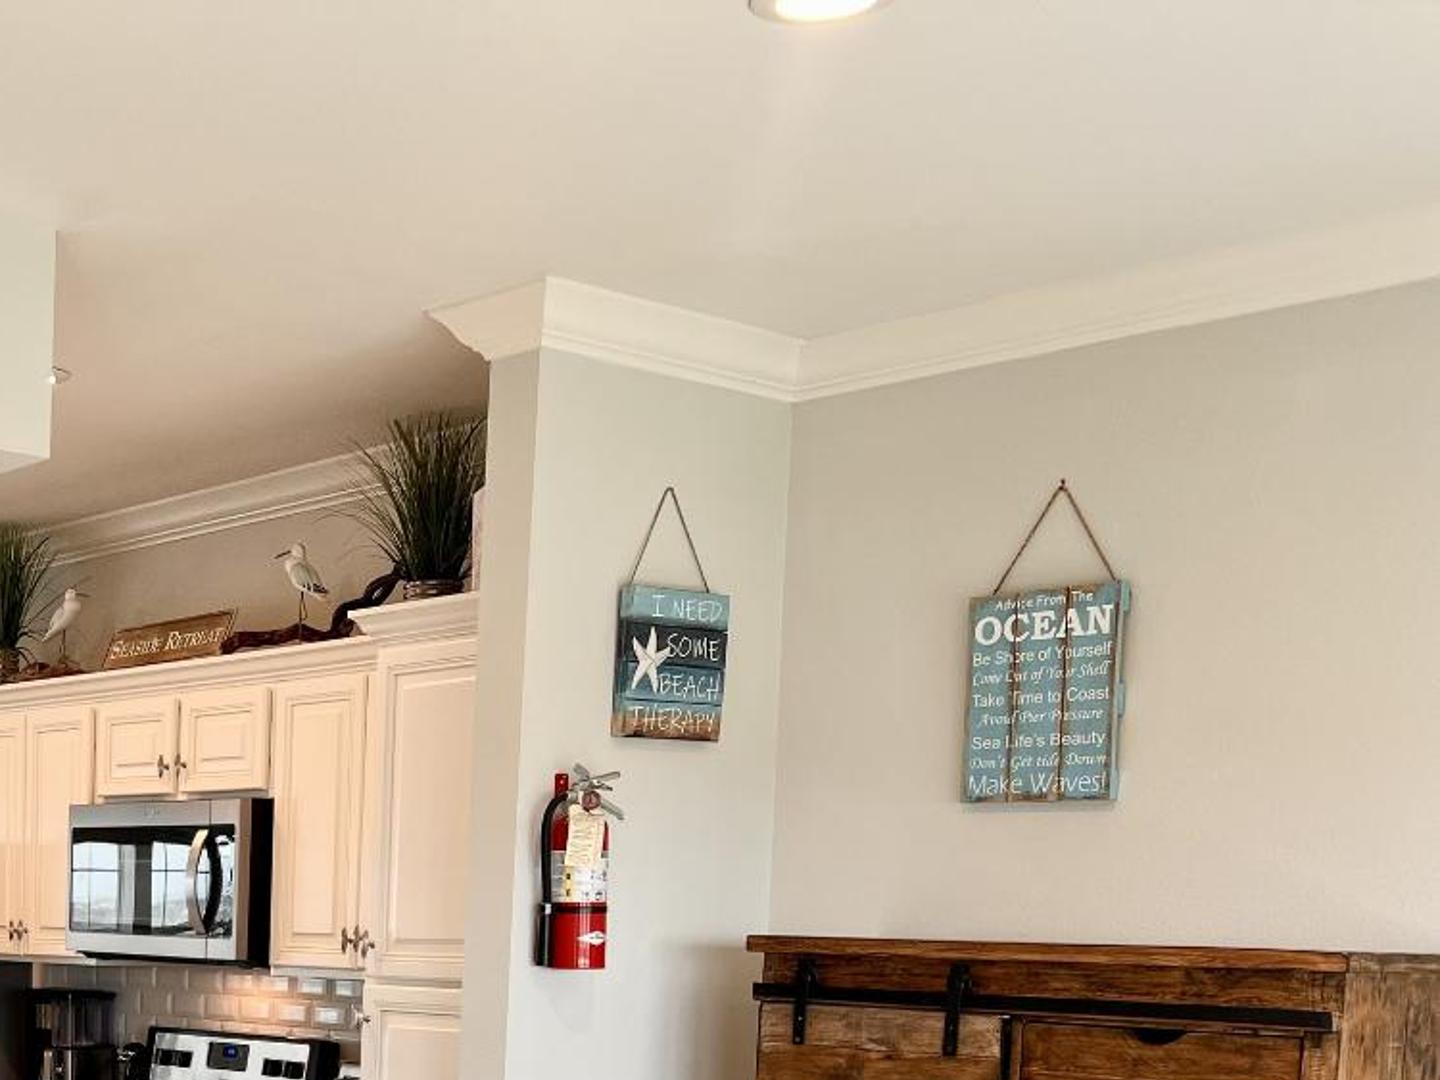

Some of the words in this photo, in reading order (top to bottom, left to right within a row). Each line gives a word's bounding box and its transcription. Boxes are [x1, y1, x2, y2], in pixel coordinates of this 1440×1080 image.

[652, 594, 665, 618] I
[673, 599, 723, 622] NEED
[1036, 594, 1067, 608] From
[1071, 590, 1094, 602] The
[974, 604, 1115, 646] OCEAN
[667, 632, 721, 662] SOME
[972, 652, 991, 667] Be
[994, 651, 1036, 665] Shore
[1037, 648, 1053, 662] of
[1055, 640, 1113, 660] Yourself
[1030, 667, 1044, 684] of
[1077, 660, 1113, 678] Shell
[658, 672, 721, 702] BEACH
[972, 693, 1005, 708] Take
[1009, 690, 1043, 705] Time
[1047, 690, 1060, 704] to
[1066, 687, 1110, 702] Coast
[628, 704, 717, 734] THERAPY
[971, 736, 1002, 750] Sea
[1005, 734, 1047, 748] Life's
[1050, 731, 1107, 748] Beauty
[969, 774, 1023, 796] Make
[1030, 771, 1107, 795] Waves!
